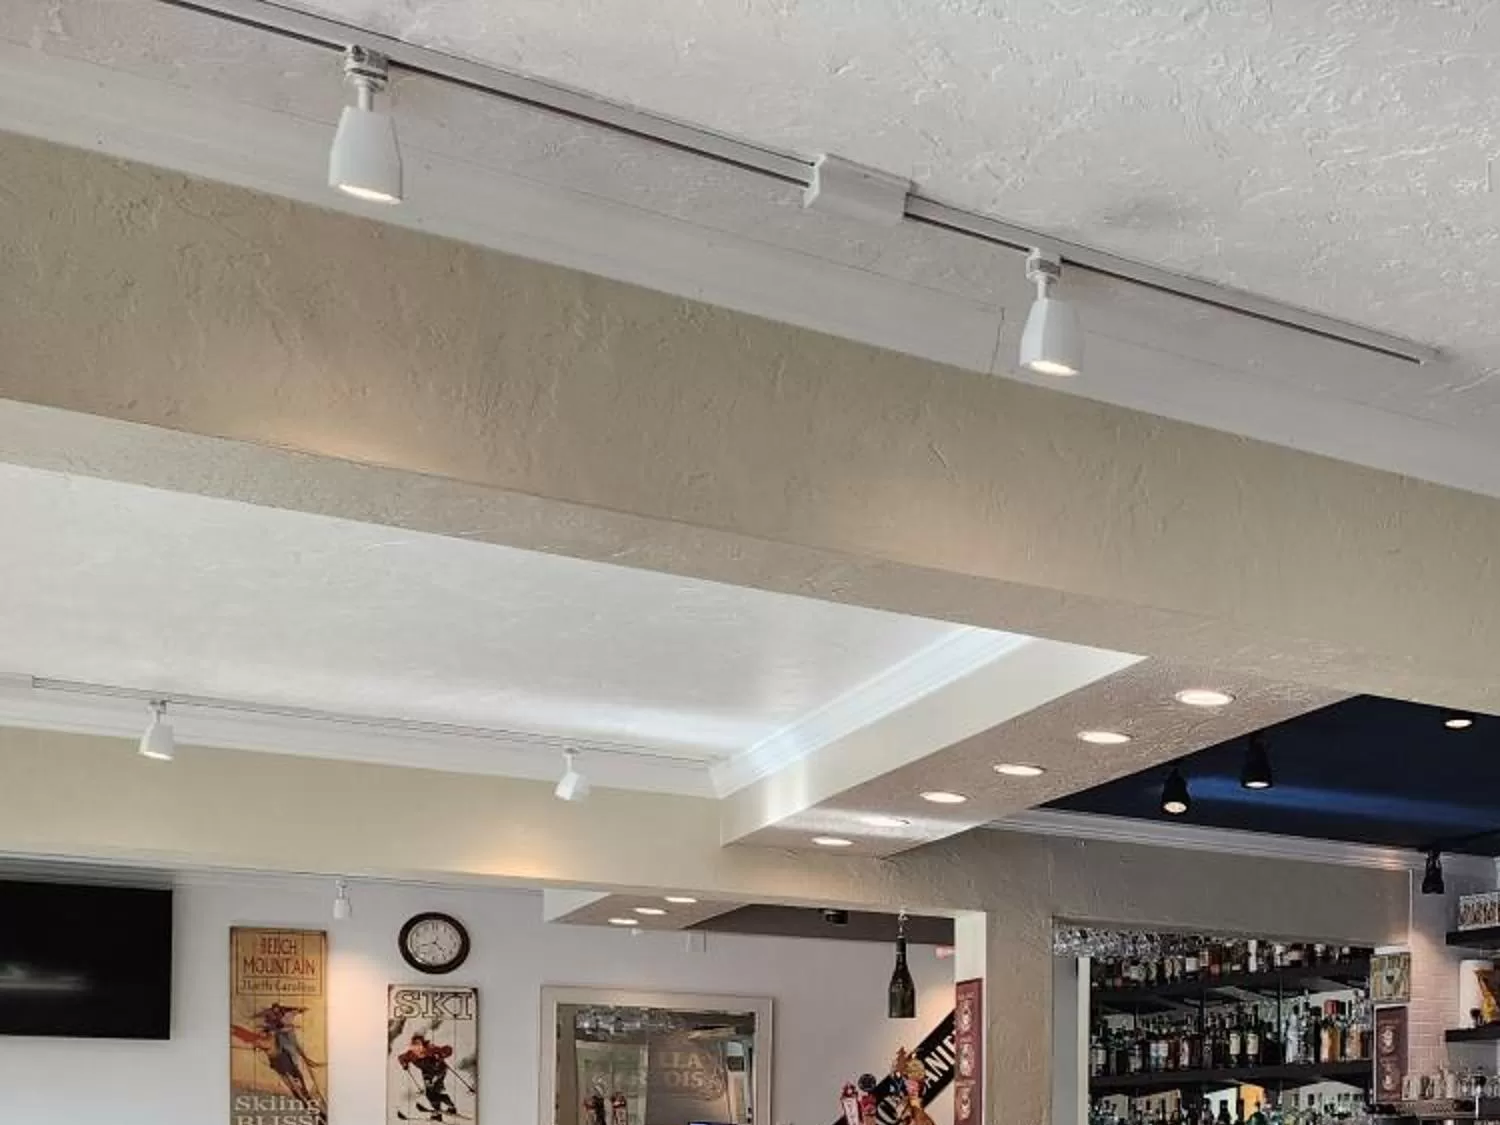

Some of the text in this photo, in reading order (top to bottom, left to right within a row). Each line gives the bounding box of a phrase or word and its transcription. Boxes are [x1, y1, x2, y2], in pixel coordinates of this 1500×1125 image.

[260, 937, 296, 955] BEECH
[243, 956, 315, 974] MOUNTAIN
[393, 990, 472, 1020] SKI
[235, 1095, 320, 1115] Skiing
